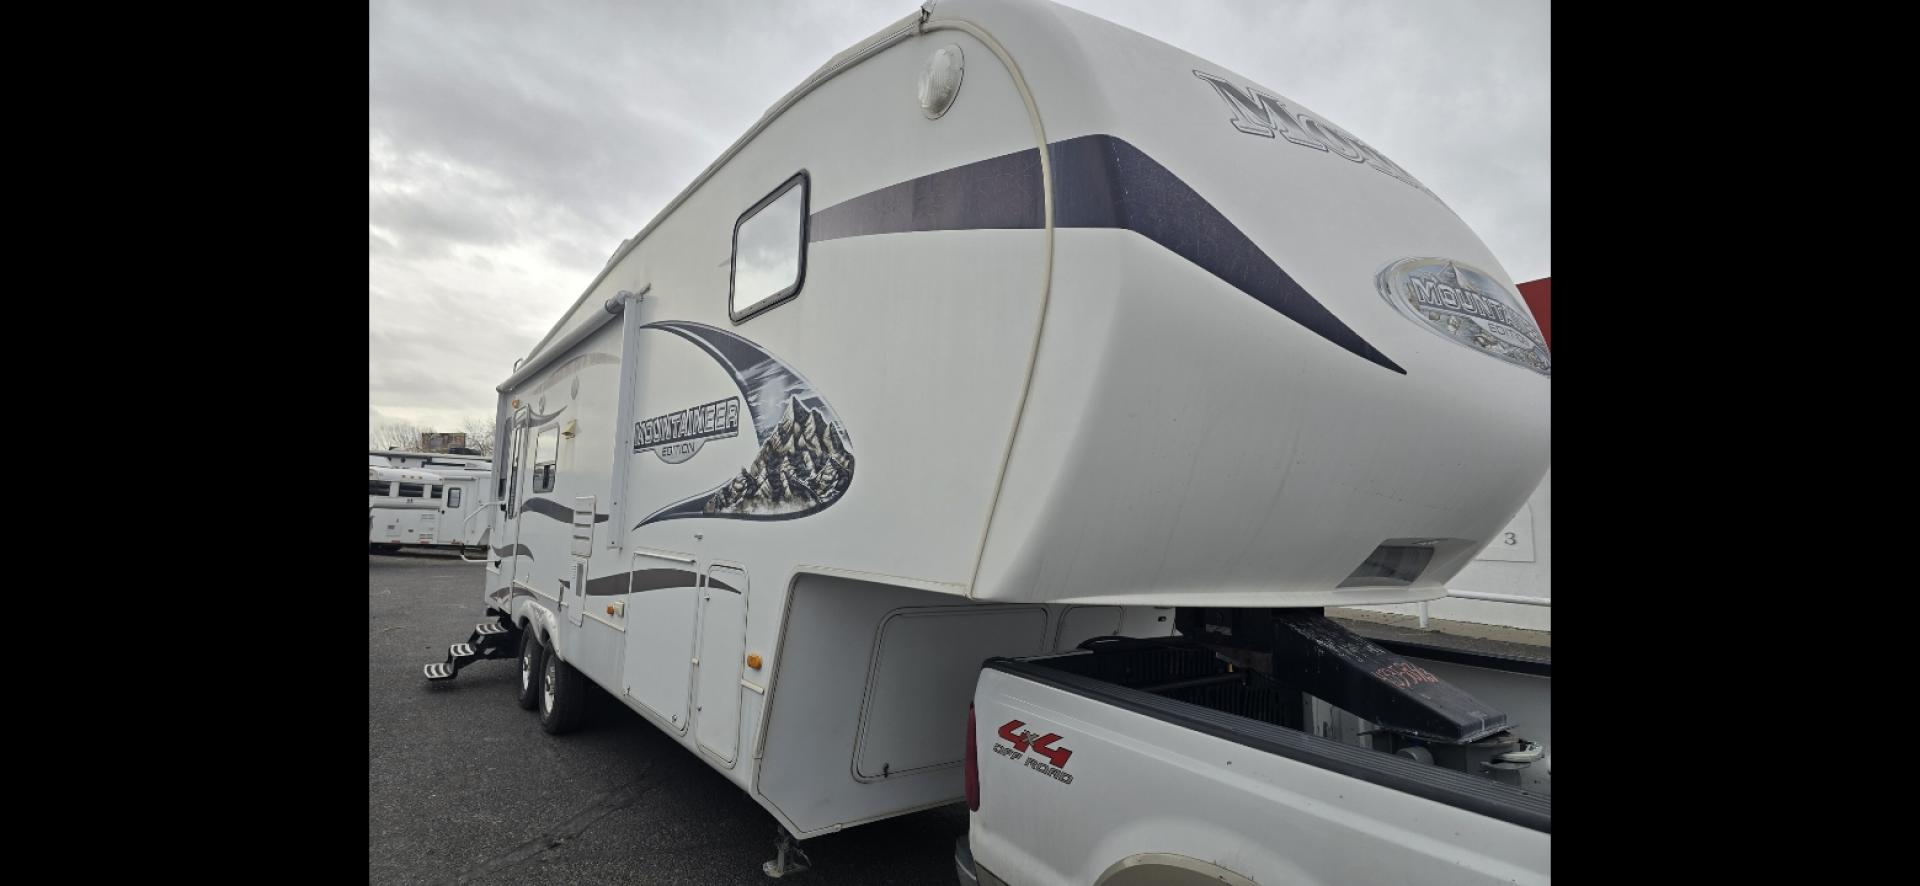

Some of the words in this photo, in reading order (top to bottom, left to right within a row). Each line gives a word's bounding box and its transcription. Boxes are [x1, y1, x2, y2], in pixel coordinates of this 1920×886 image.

[634, 399, 739, 447] MOUNTAINEER
[661, 443, 695, 457] EDITION
[1504, 532, 1516, 545] 3
[993, 743, 1023, 760] OFF
[1024, 757, 1074, 785] ROAD
